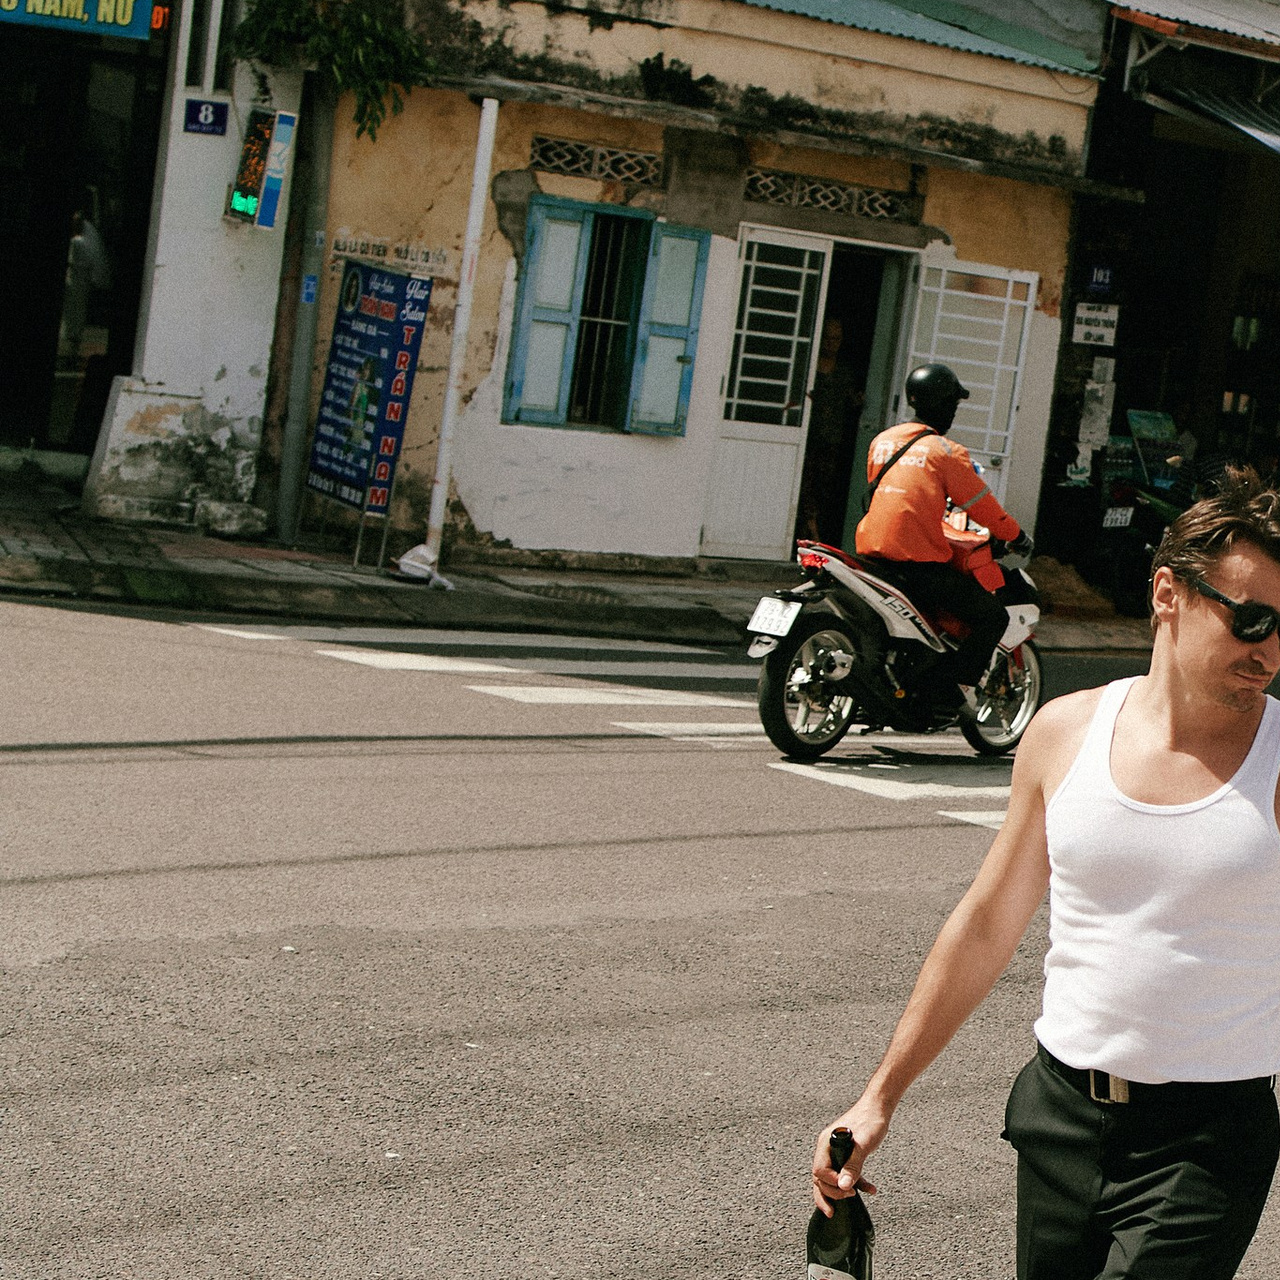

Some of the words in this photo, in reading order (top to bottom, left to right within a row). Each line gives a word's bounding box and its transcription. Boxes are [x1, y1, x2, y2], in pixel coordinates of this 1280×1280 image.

[198, 103, 214, 124] 8
[898, 455, 927, 468] ood
[880, 596, 916, 620] 150
